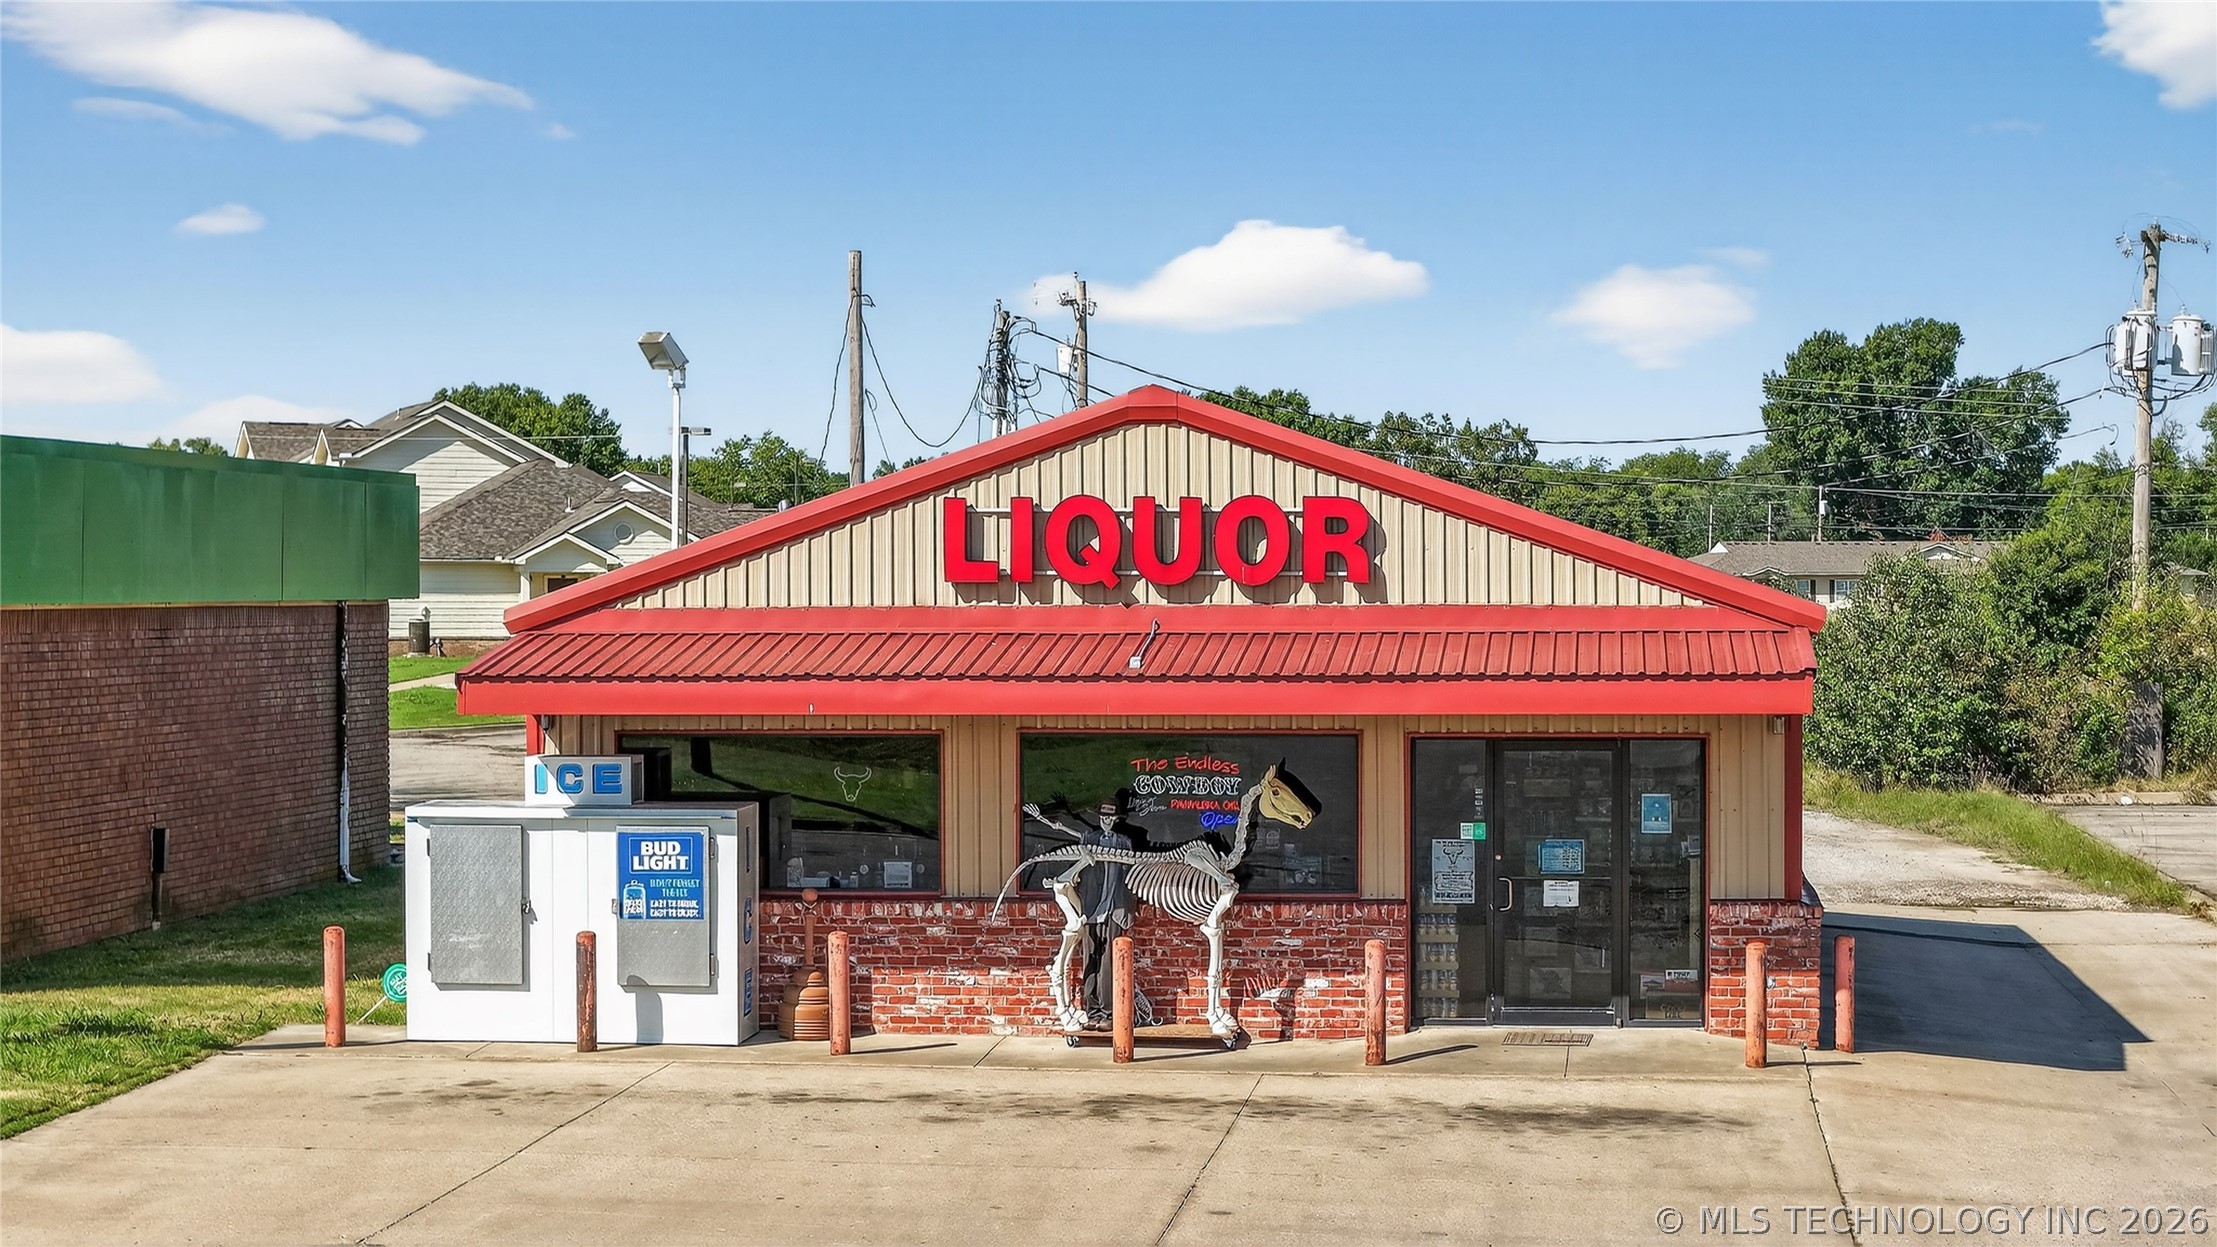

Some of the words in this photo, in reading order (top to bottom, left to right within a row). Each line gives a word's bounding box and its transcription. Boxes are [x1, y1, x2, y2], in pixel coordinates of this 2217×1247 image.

[943, 494, 1370, 590] LIQUOR
[1130, 758, 1168, 773] The
[1174, 755, 1241, 775] Endless
[534, 762, 624, 795] ICE
[1133, 774, 1242, 795] COWBOY
[640, 840, 682, 856] BUD
[632, 855, 690, 871] LIGHT
